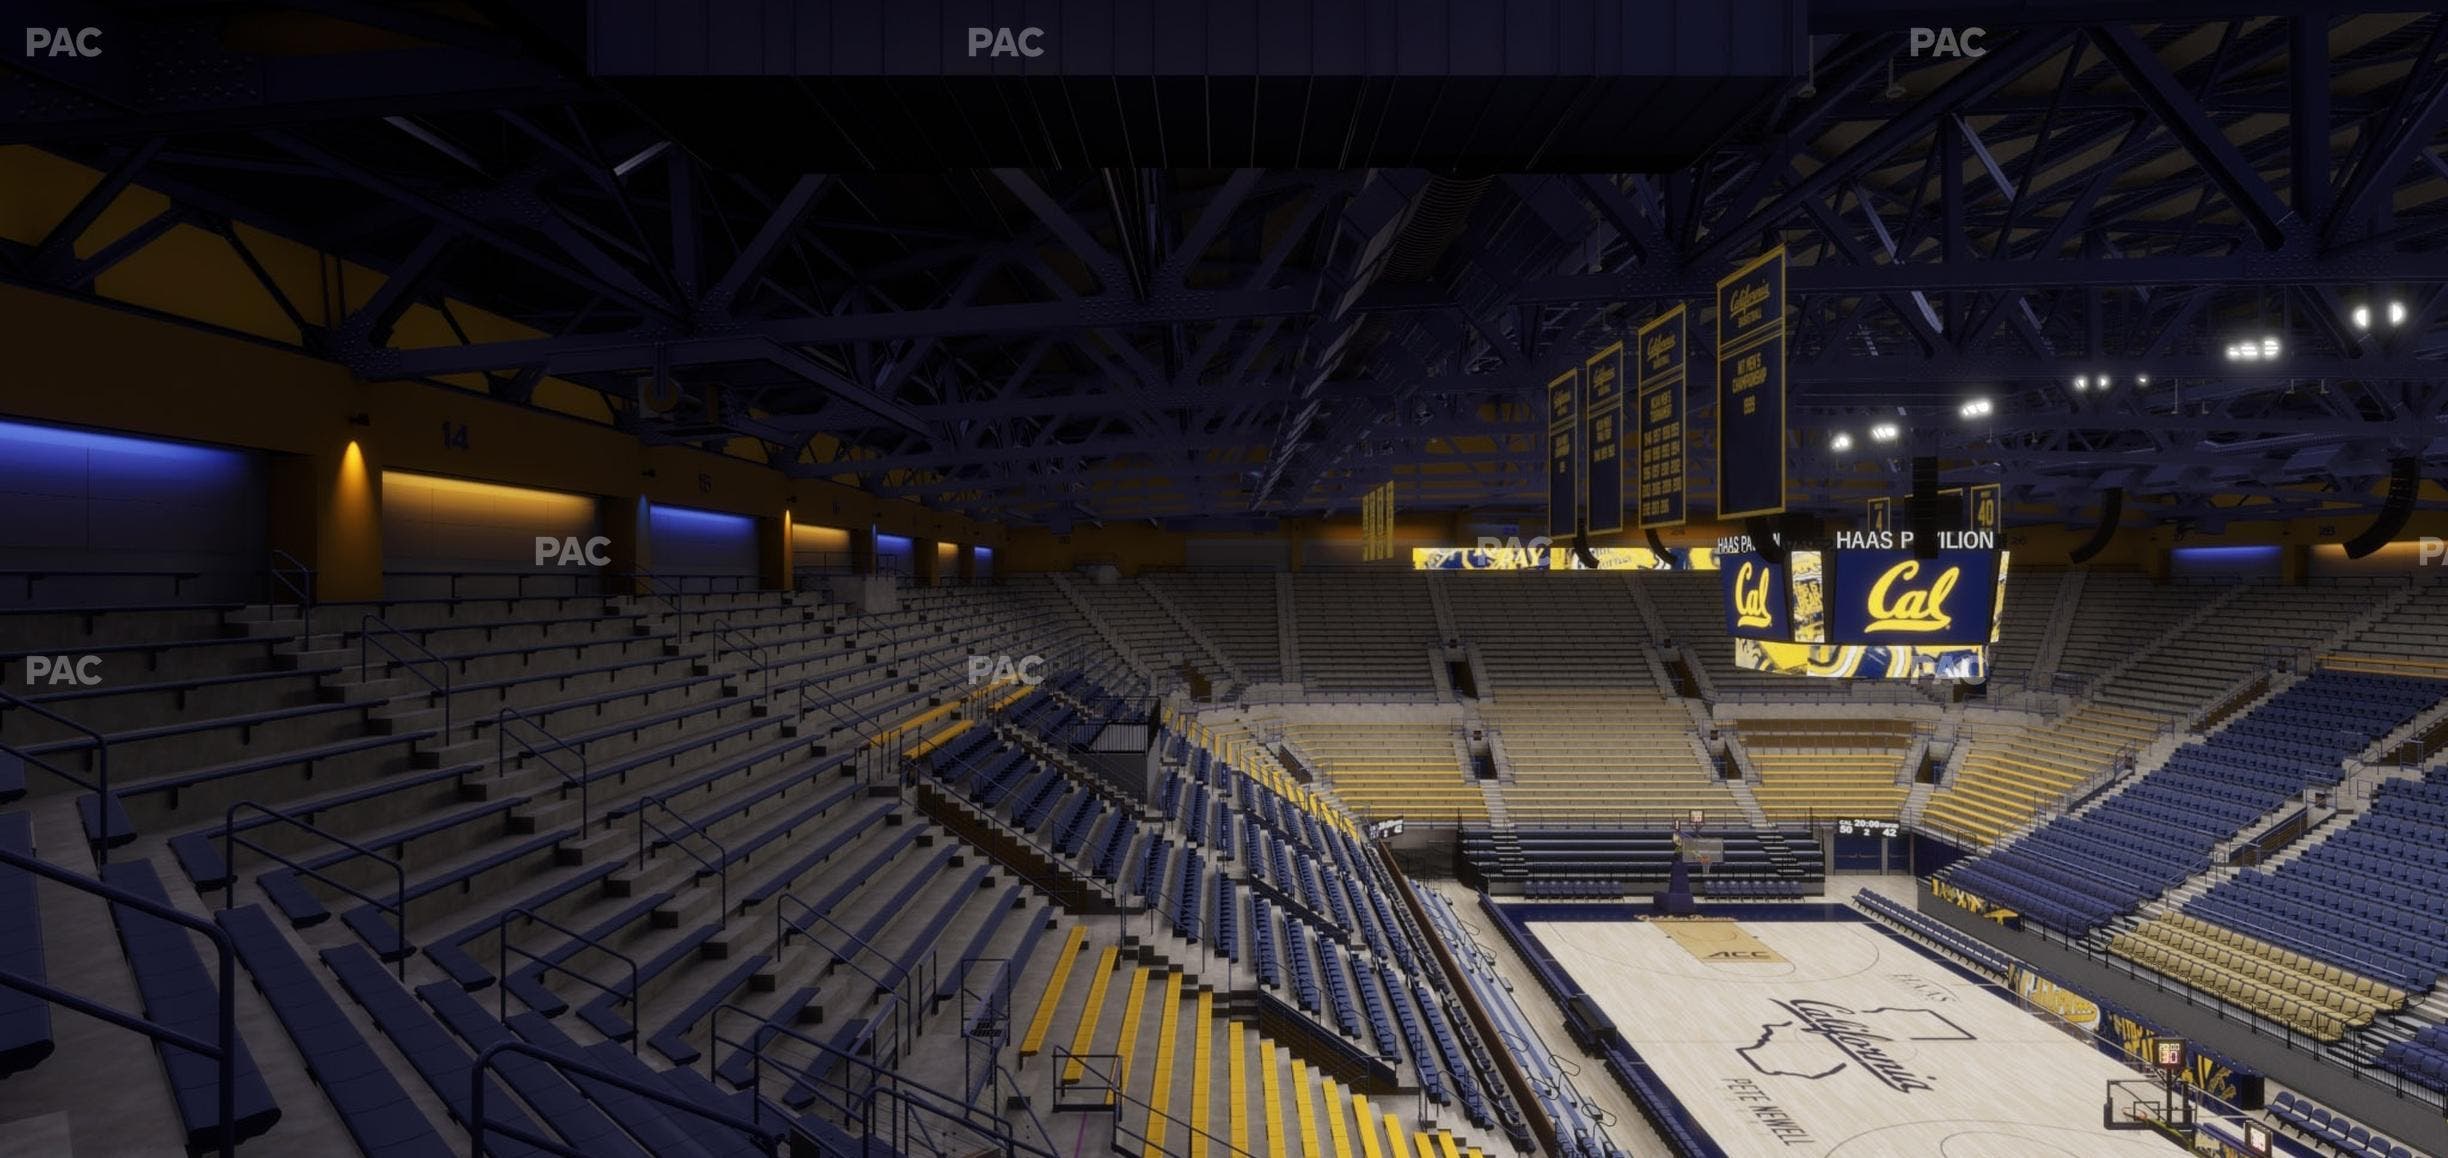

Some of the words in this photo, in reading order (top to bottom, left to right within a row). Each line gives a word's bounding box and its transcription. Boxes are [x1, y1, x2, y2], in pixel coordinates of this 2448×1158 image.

[441, 421, 469, 449] 14
[1977, 498, 1994, 527] 40
[1717, 536, 1740, 553] HAAS
[1836, 531, 1893, 550] HAAS
[1901, 531, 1994, 550] PILION
[1735, 561, 1773, 628] Cal
[1863, 560, 1960, 633] Cal
[1839, 825, 1853, 834] 50
[1863, 828, 1871, 836] 2
[1882, 828, 1897, 837] 42
[1854, 819, 1880, 828] 20:00
[1703, 951, 1771, 960] ACC
[1768, 998, 1938, 1094] California
[1721, 1078, 1773, 1102] PETE
[1749, 1105, 1817, 1147] NEWELL
